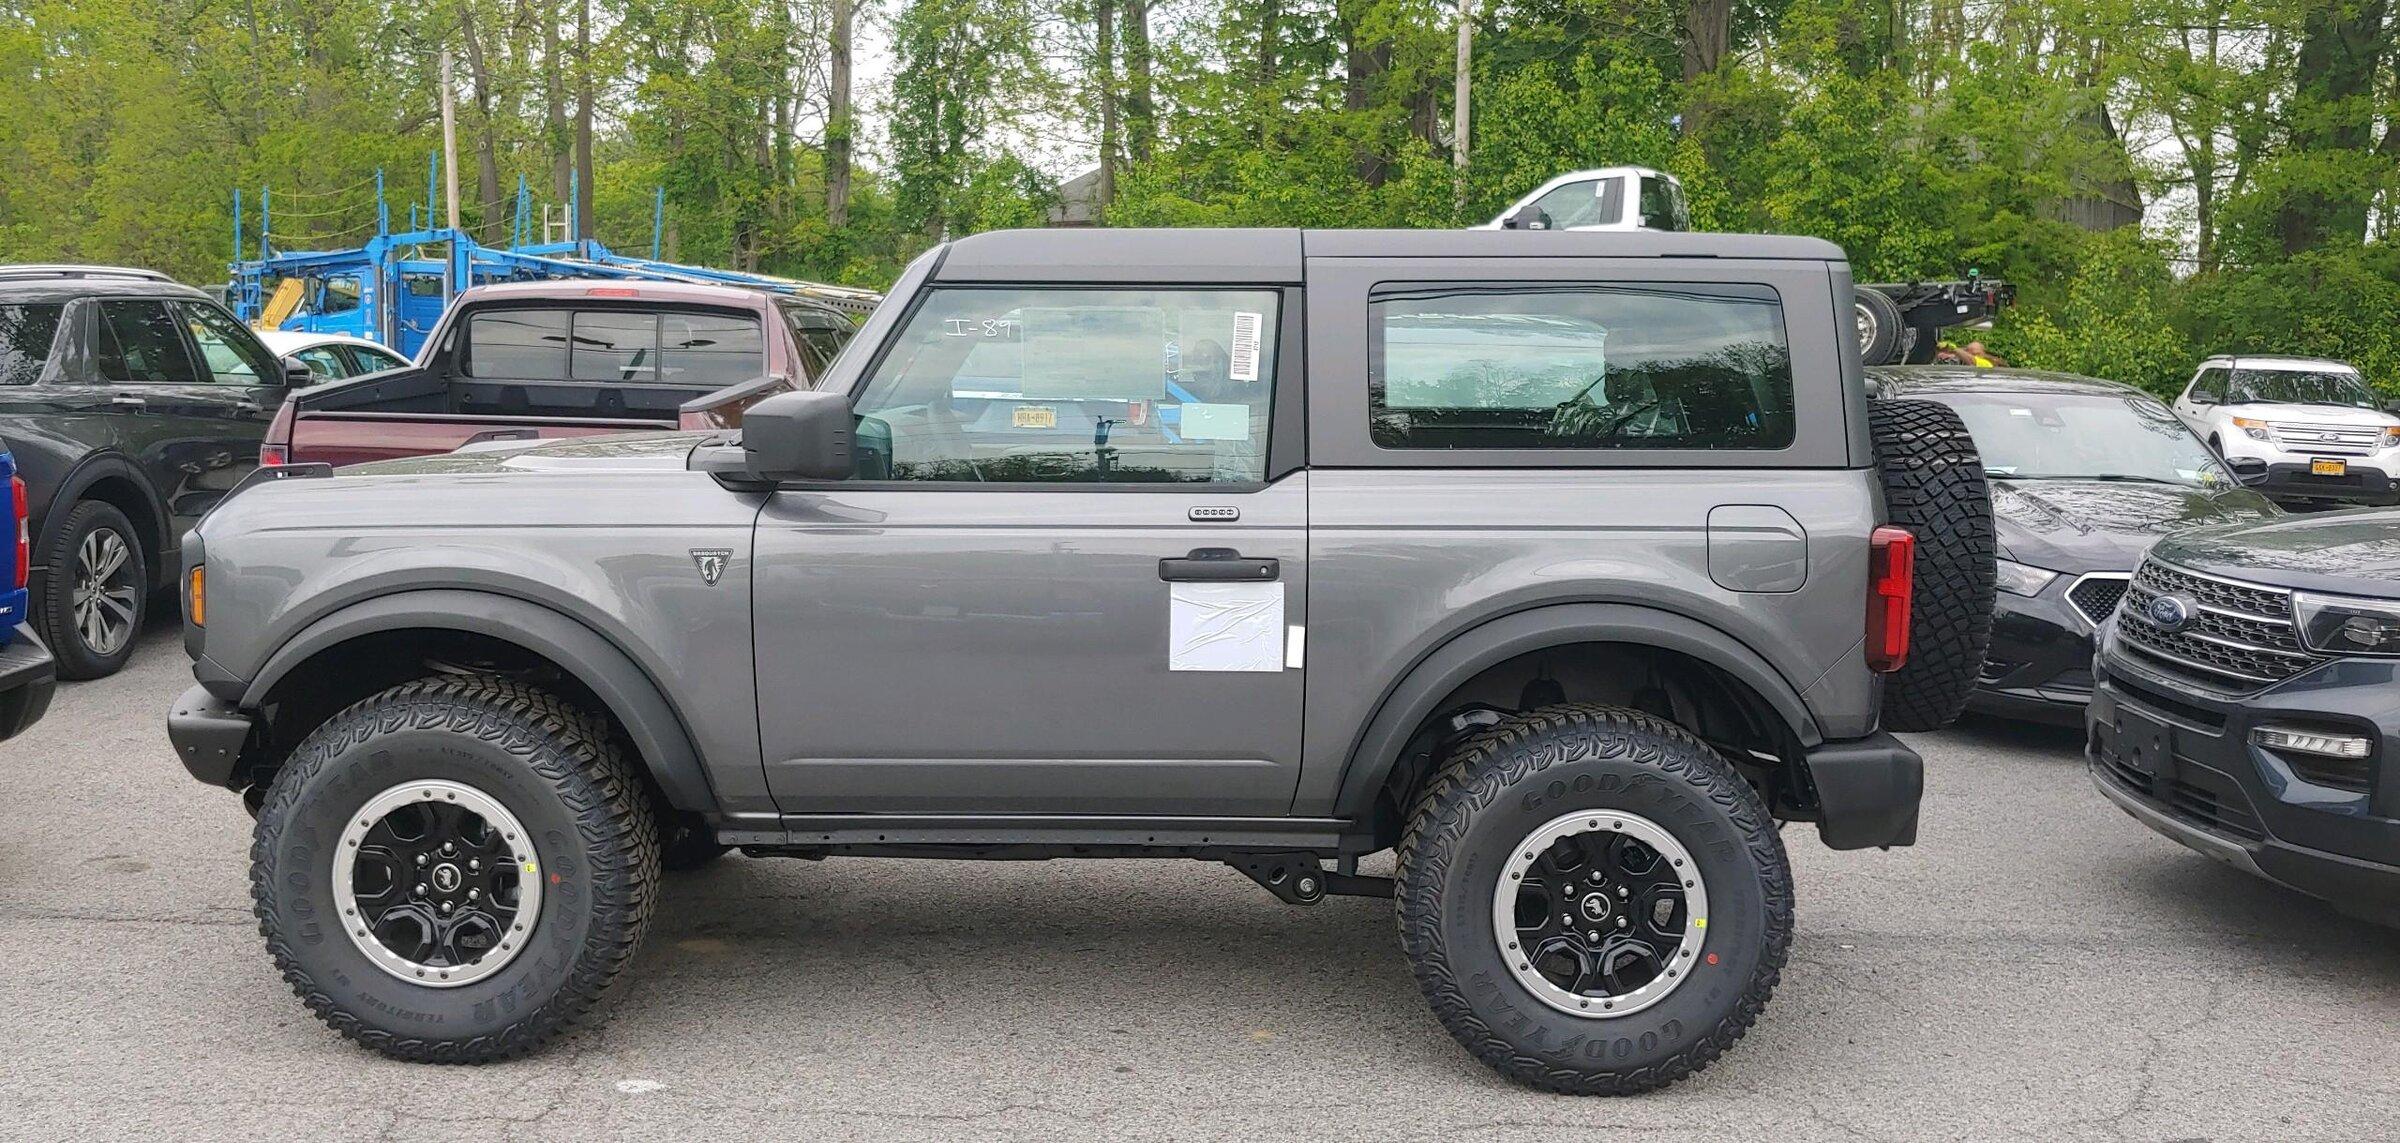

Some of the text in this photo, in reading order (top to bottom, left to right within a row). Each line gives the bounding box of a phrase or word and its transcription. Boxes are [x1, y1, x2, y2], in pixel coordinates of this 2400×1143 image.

[1521, 773, 1736, 864] GOODYEAR
[472, 829, 577, 1023] GOODYEAR
[1471, 968, 1683, 1060] GOODYEAR
